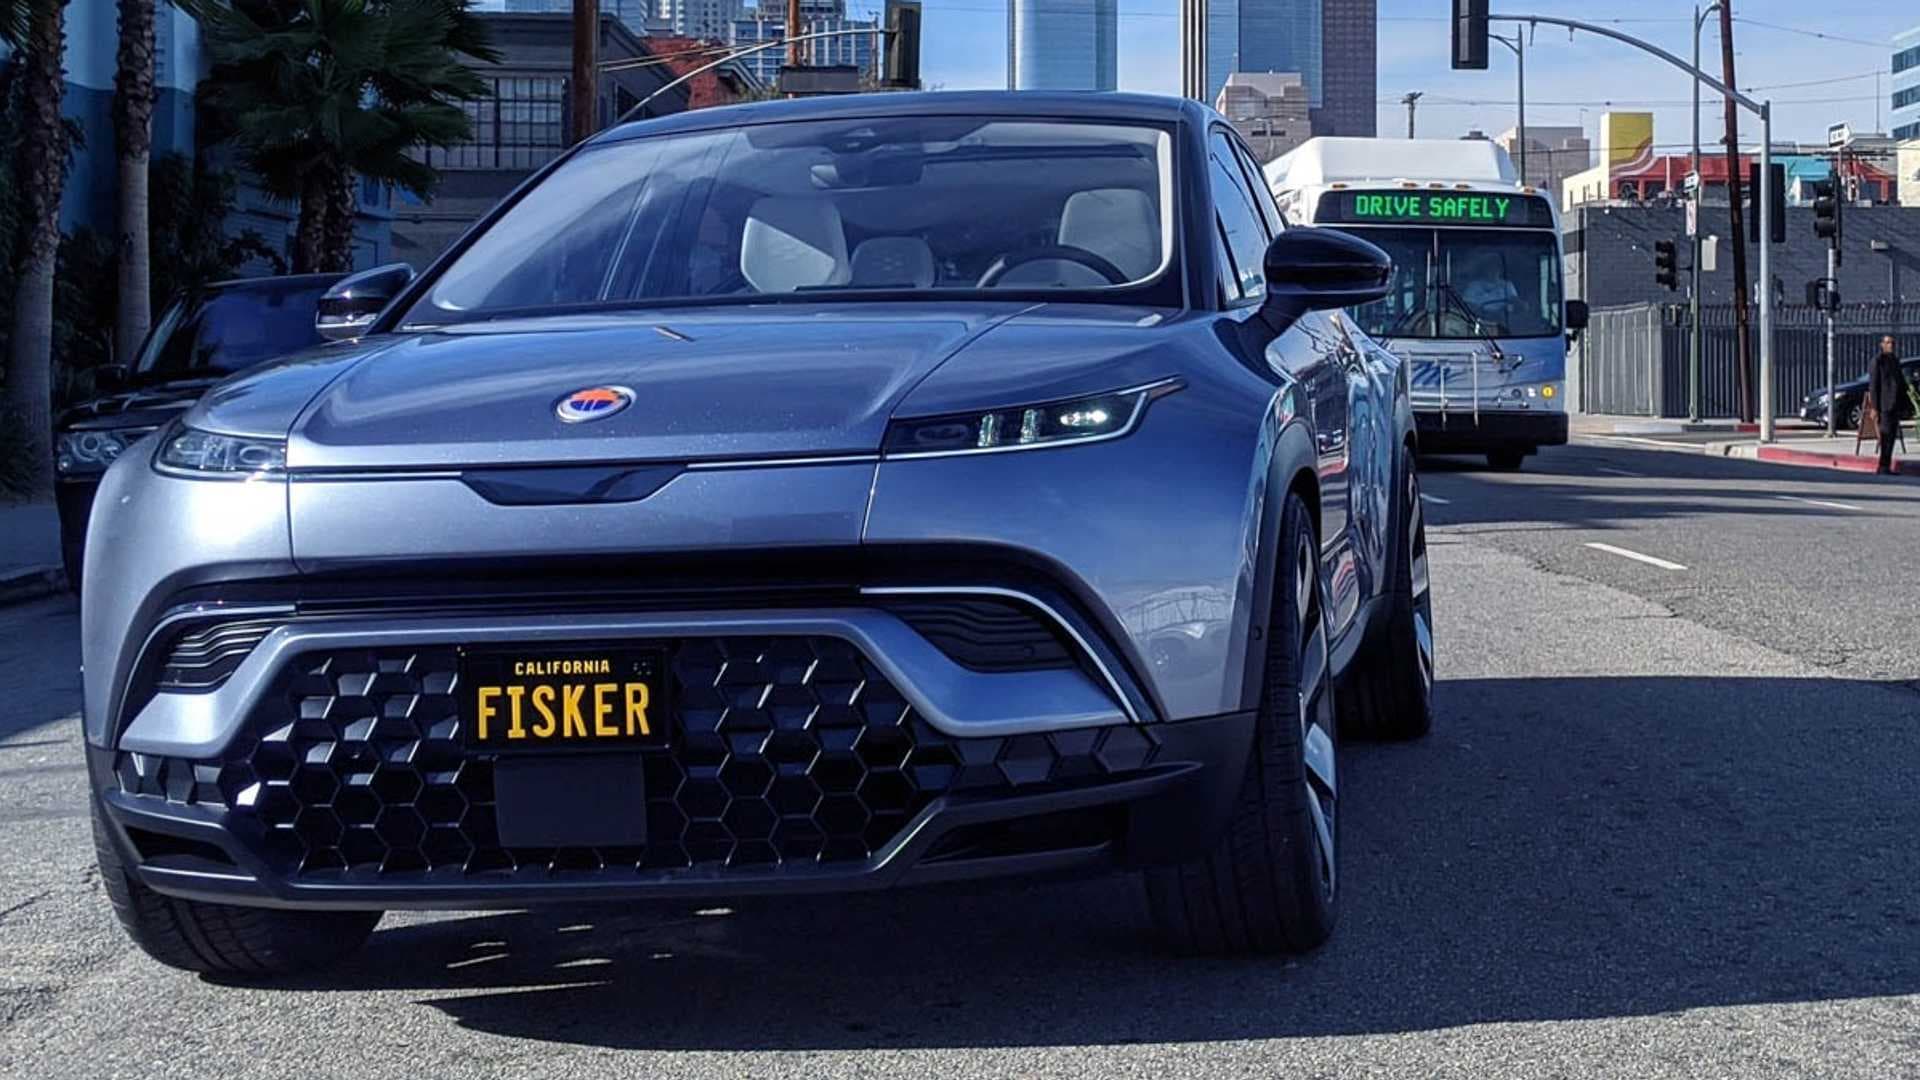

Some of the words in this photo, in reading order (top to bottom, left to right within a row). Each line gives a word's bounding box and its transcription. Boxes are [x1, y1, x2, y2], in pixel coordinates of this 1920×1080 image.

[1355, 195, 1420, 217] DRIVE
[1429, 198, 1510, 218] SAFELY
[514, 659, 611, 675] CALIFORNIA
[478, 683, 651, 739] FISKER
